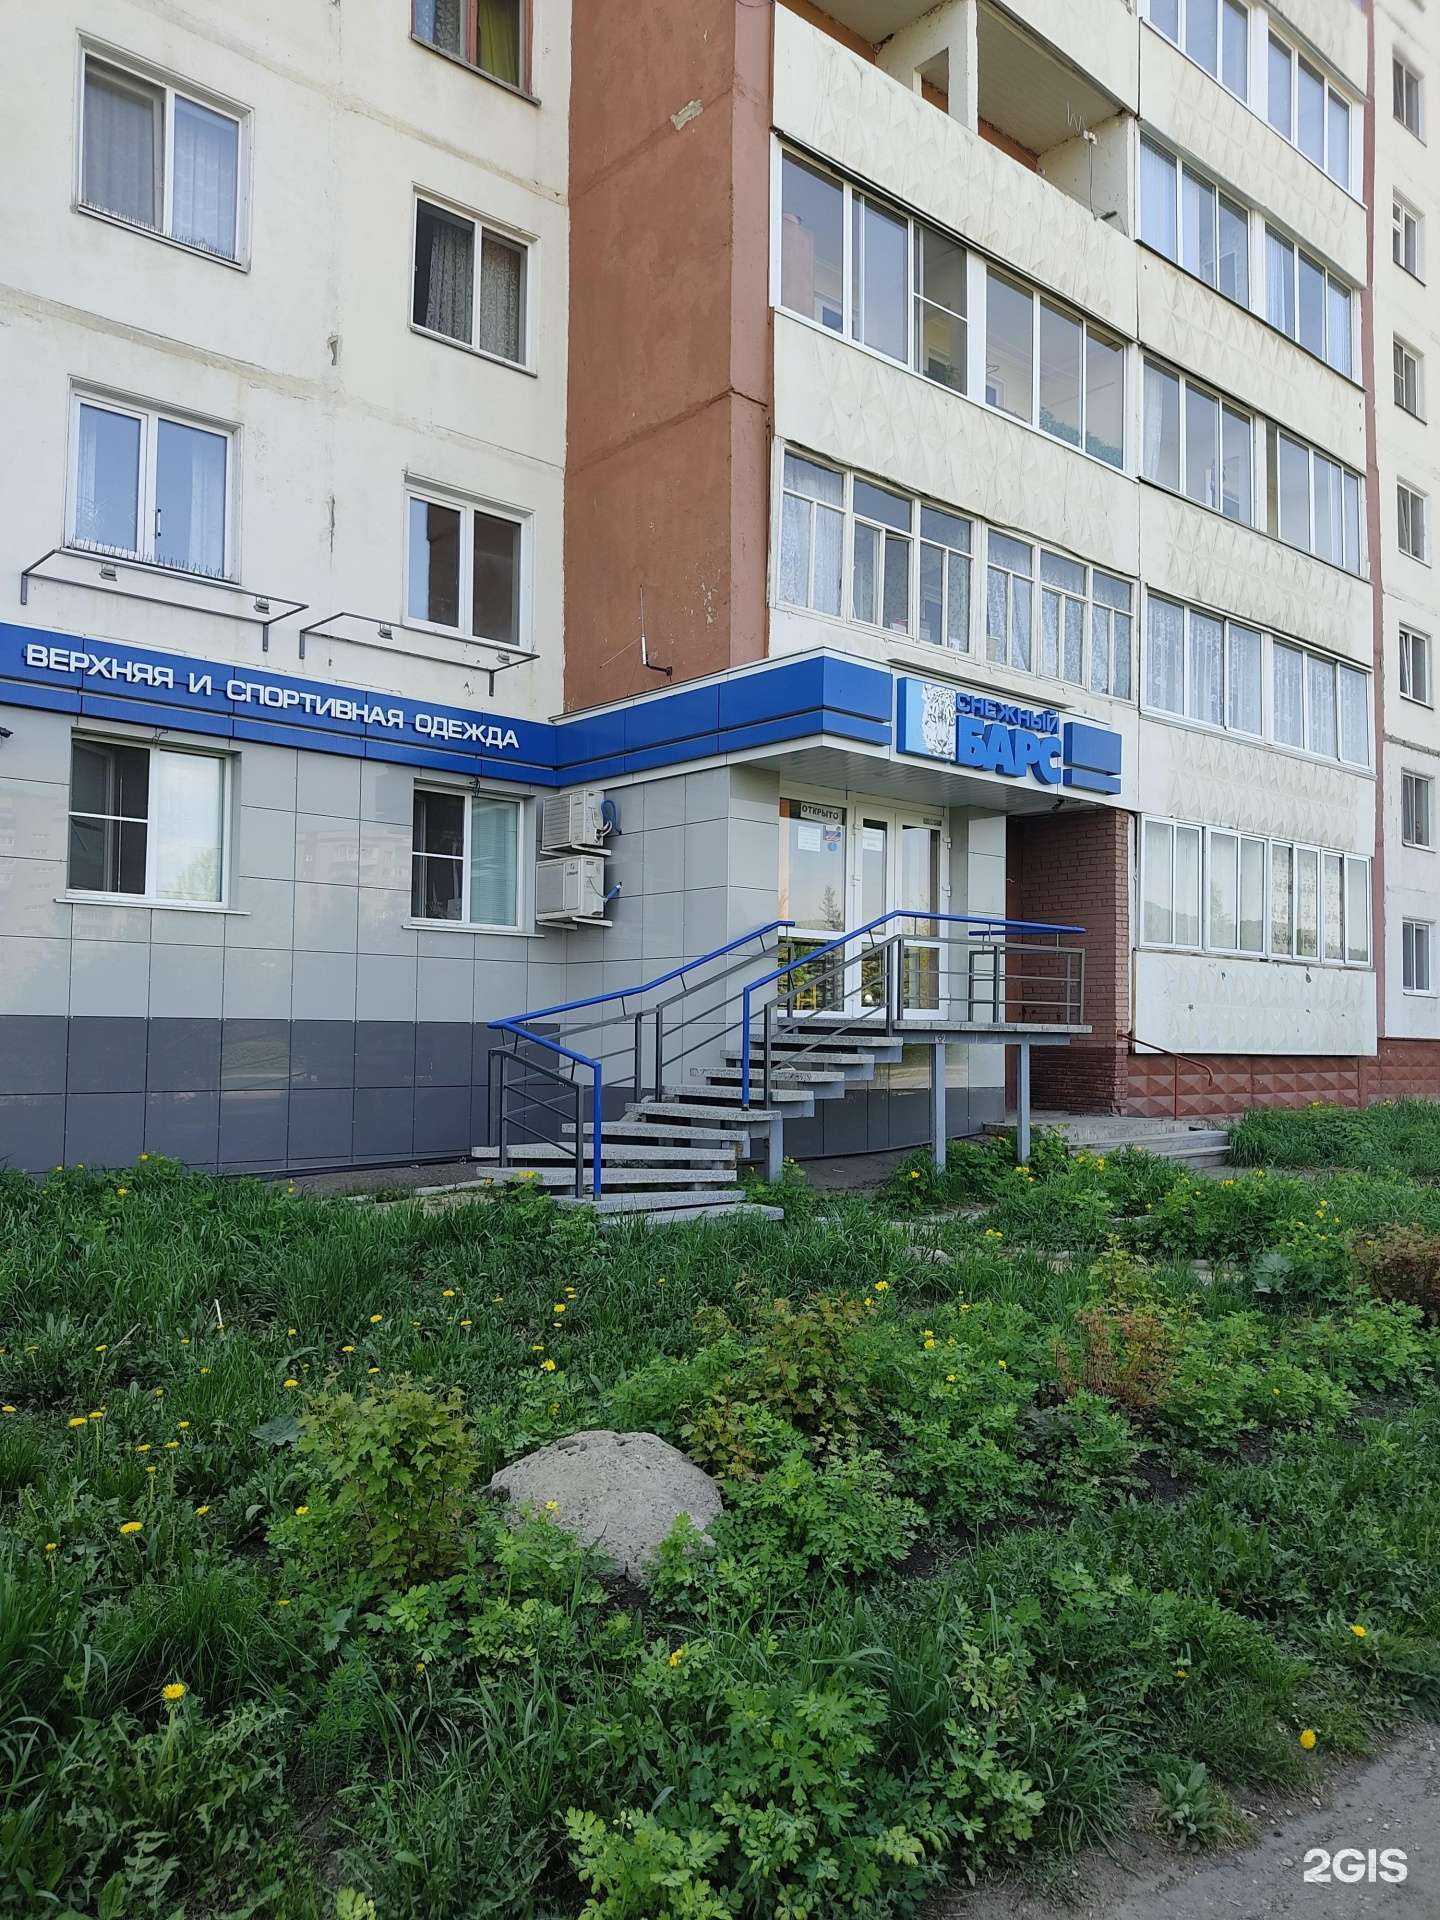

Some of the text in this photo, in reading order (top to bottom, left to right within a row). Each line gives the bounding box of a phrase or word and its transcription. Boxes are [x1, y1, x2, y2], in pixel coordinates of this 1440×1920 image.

[25, 643, 519, 749] ВЕРХНЯЯ И СПОРТИВНАЯ ОДЕЖДА
[956, 692, 1059, 735] СНЕЖНЫЙ
[956, 715, 1062, 785] БАРС
[802, 804, 839, 820] ОТКРЫТО
